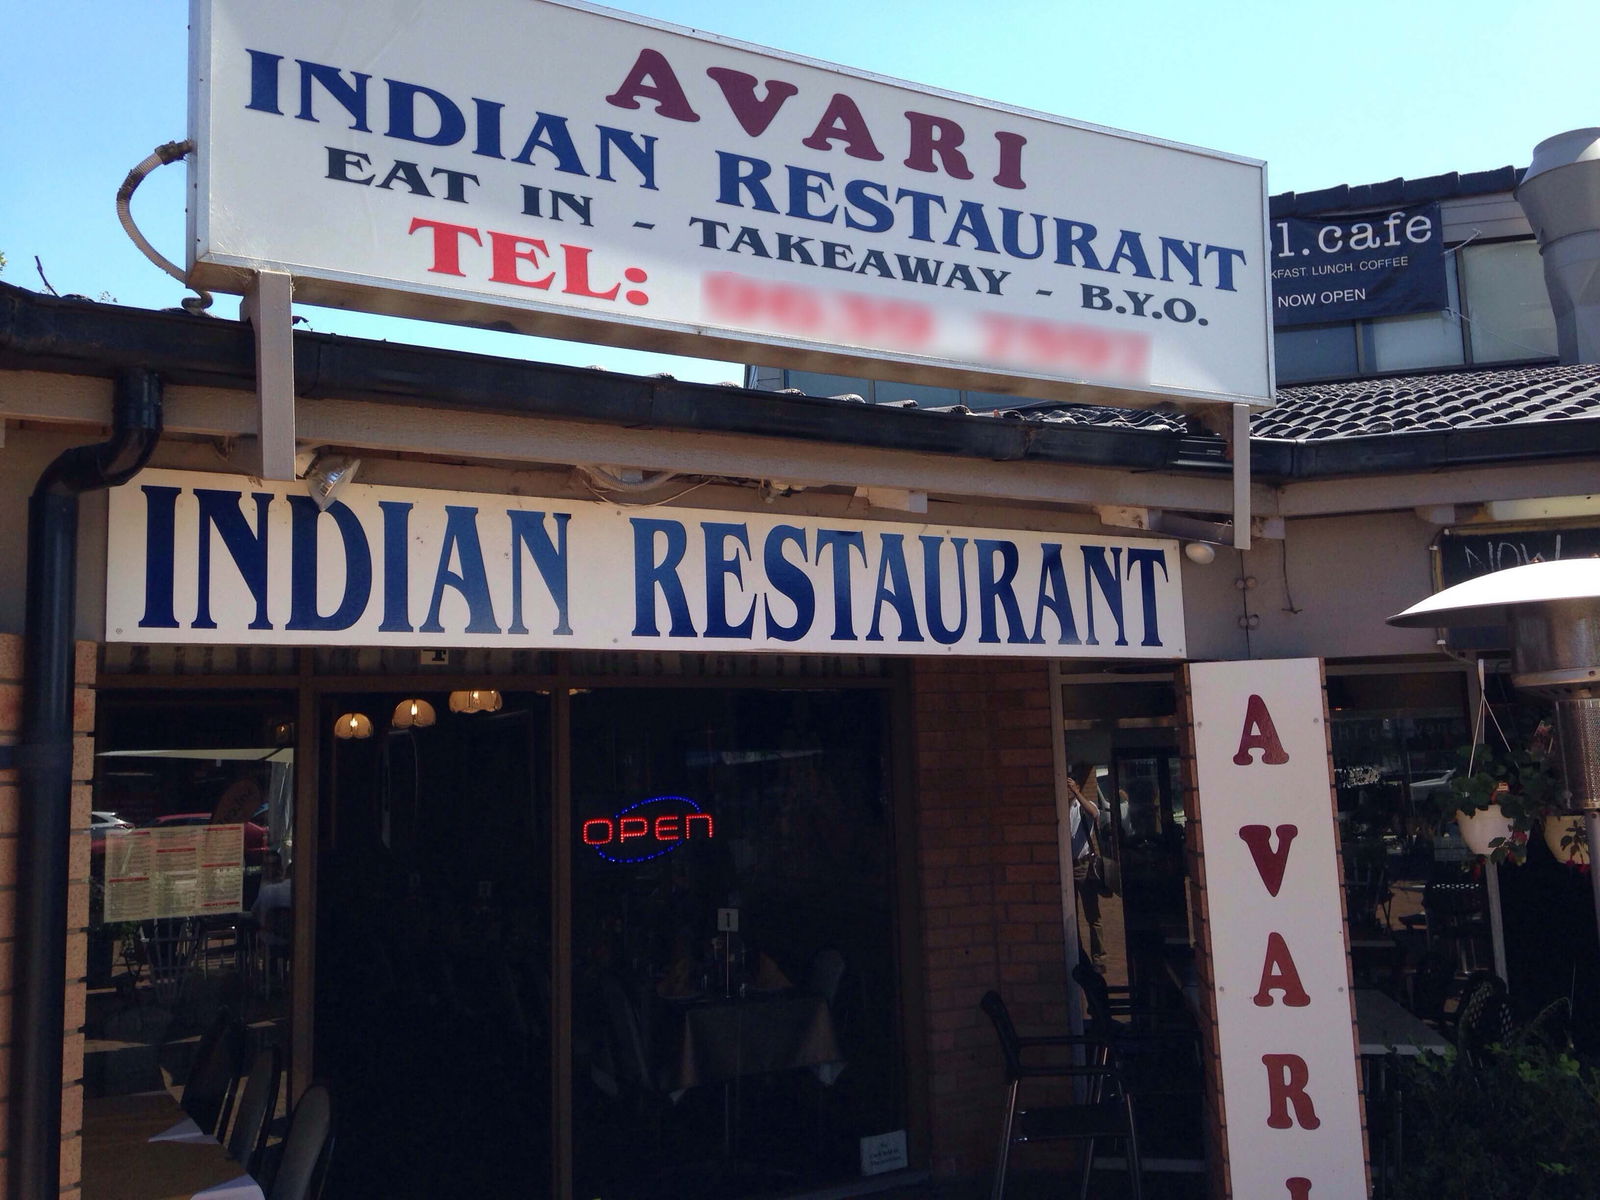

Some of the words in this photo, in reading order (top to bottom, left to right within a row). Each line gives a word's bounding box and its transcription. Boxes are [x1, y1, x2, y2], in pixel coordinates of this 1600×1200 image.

[245, 49, 660, 191] INDIAN
[715, 150, 1246, 292] RESTAURANT
[608, 49, 1025, 189] AVARI
[324, 146, 480, 204] EAT
[520, 184, 594, 227] IN
[689, 217, 1012, 296] TAKEAWAY
[1081, 283, 1209, 326] B.Y.O.
[408, 217, 649, 306] TEL:
[1359, 256, 1409, 271] COFFEE
[1278, 293, 1316, 308] NOW
[1320, 288, 1366, 304] OPEN
[138, 484, 574, 635] INDIAN
[629, 517, 1169, 647] RESTAURANT
[583, 813, 714, 845] OPEN
